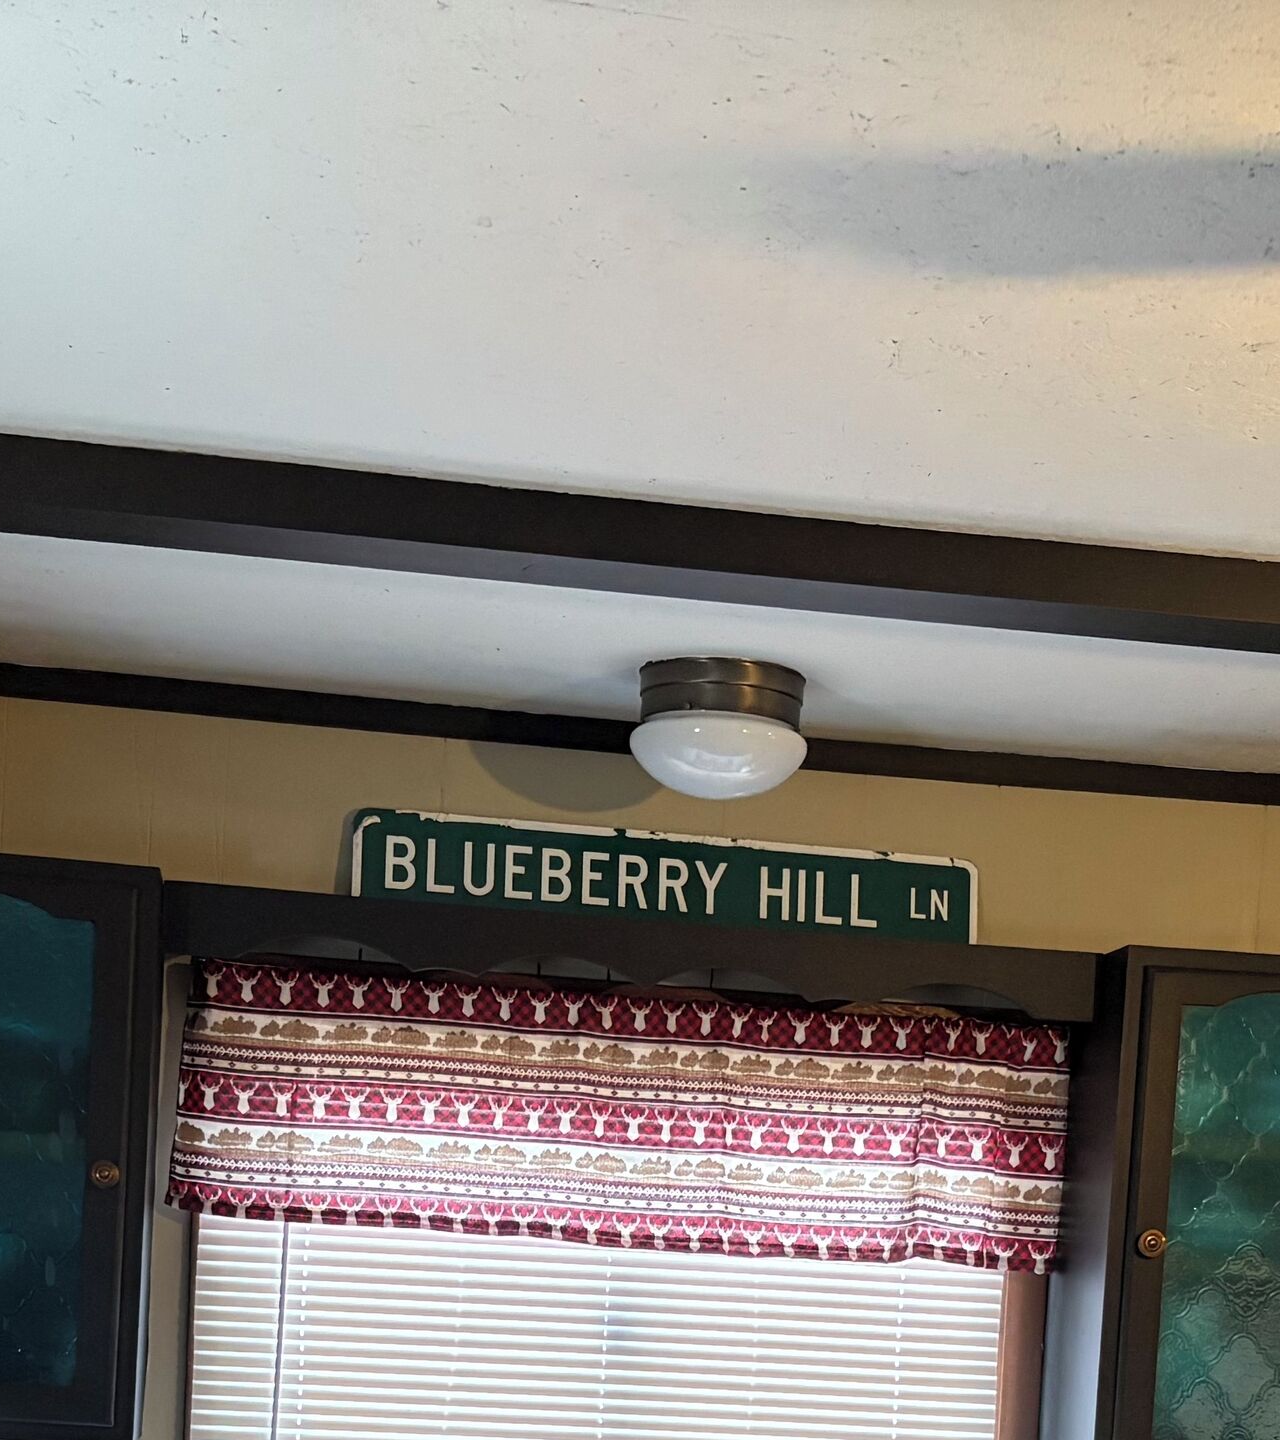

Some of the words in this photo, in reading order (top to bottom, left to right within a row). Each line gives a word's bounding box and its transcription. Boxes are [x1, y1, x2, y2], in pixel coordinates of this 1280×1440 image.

[384, 834, 728, 915] BLUEBERRY
[759, 865, 878, 928] HILL
[909, 886, 949, 922] LN
